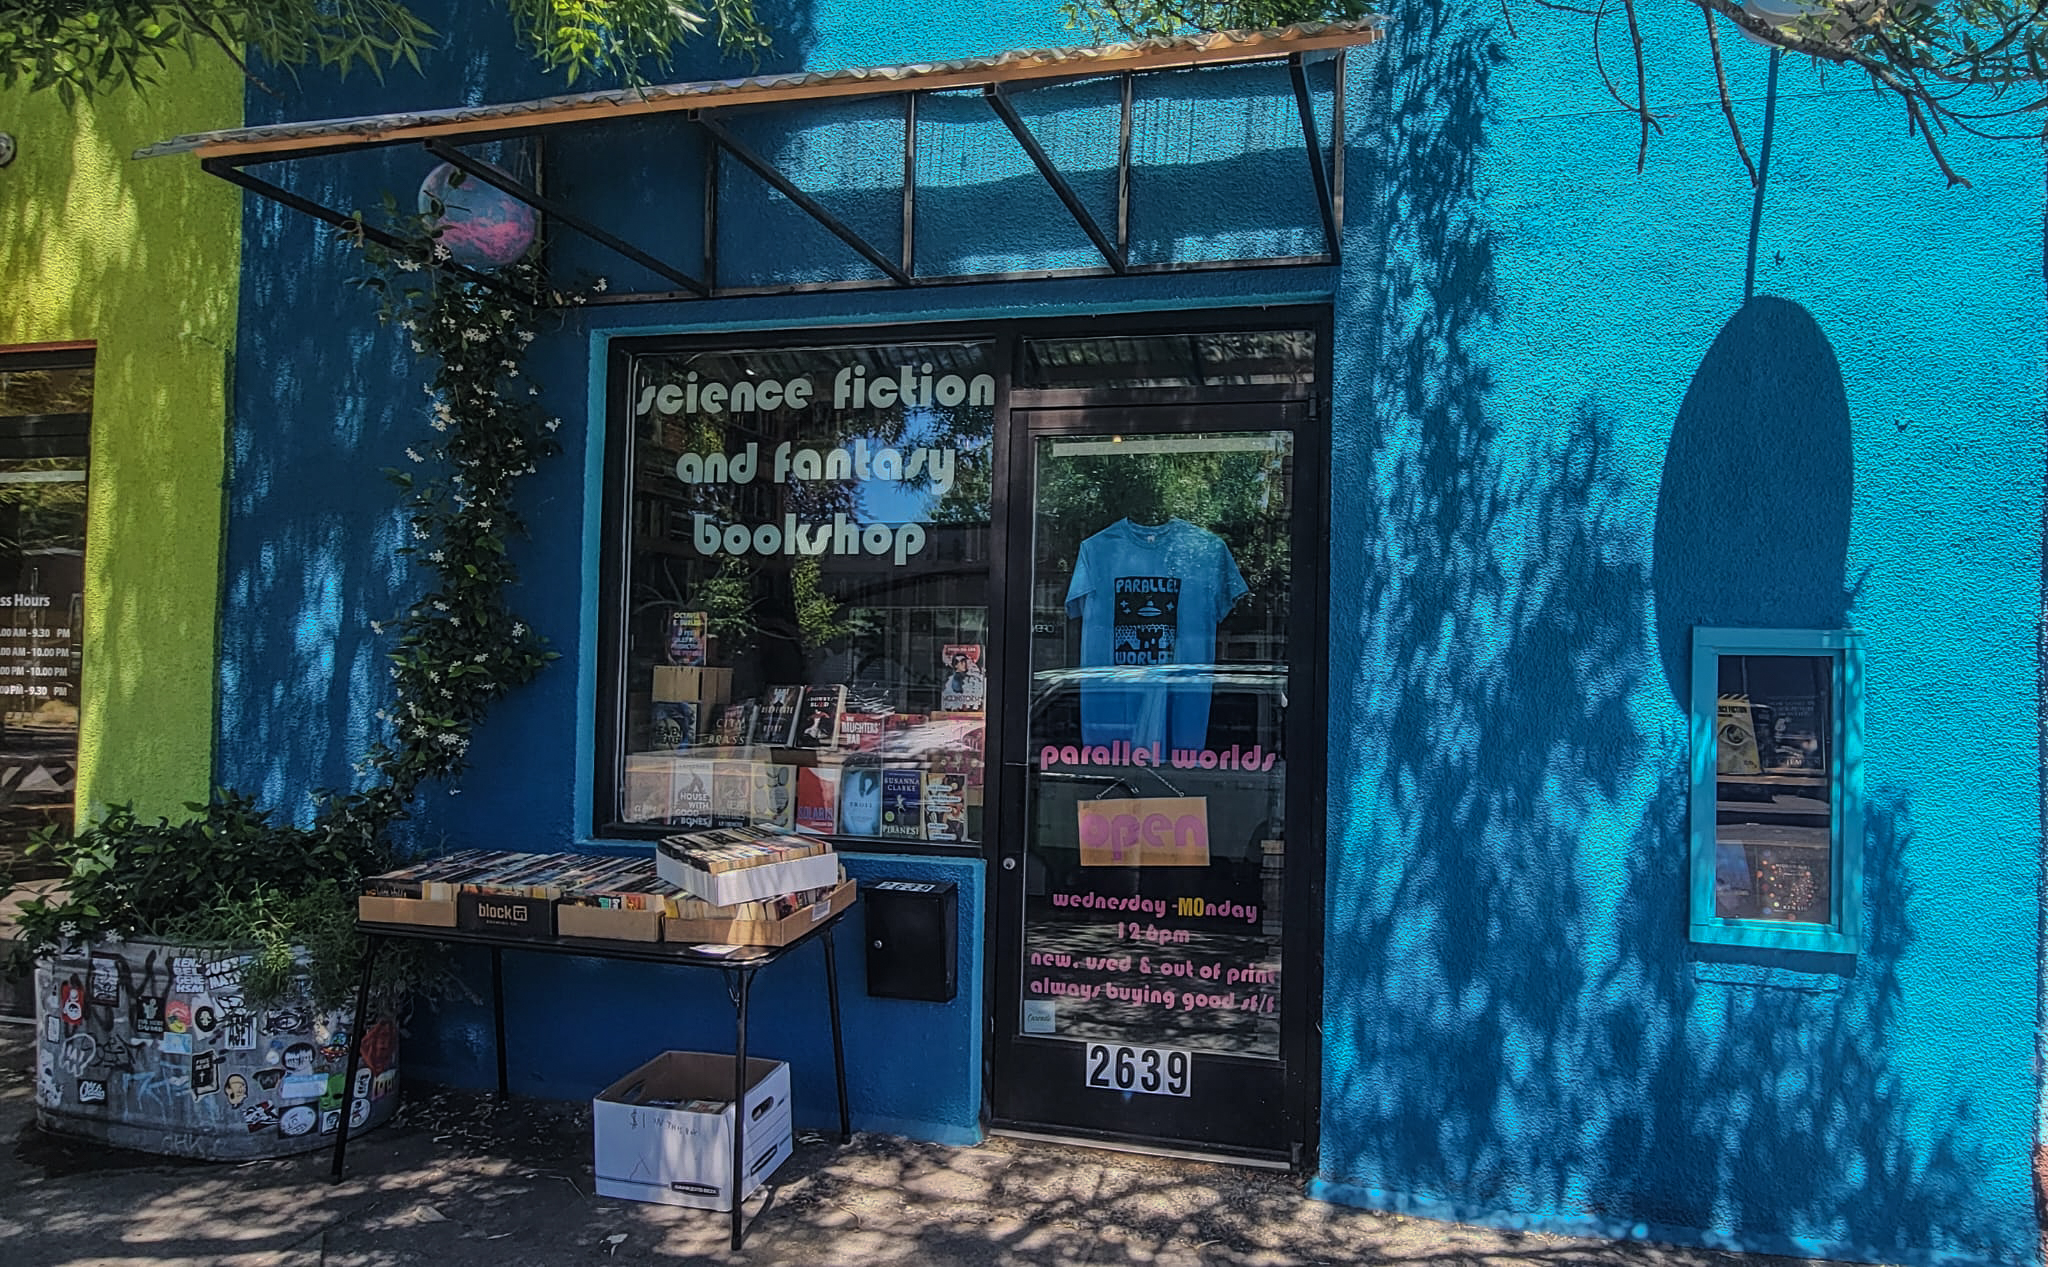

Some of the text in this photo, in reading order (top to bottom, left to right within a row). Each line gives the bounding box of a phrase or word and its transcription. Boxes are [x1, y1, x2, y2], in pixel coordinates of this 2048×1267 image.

[636, 362, 995, 416] science fiction
[676, 439, 956, 495] and fantasy
[693, 513, 926, 566] bookshop
[1115, 579, 1179, 593] PARALLEL
[14, 594, 50, 607] Hours
[13, 628, 27, 638] AM
[57, 628, 70, 638] PM
[12, 647, 26, 657] AM
[56, 648, 69, 657] PM
[11, 666, 24, 676] PM
[54, 667, 67, 677] PM
[10, 685, 24, 695] PM
[53, 686, 67, 696] PM
[1040, 740, 1276, 772] parallel worlds
[884, 777, 920, 785] SUSANNA
[680, 792, 708, 800] HOUSE
[675, 808, 700, 816] GOOD
[688, 801, 709, 809] WITH
[1081, 813, 1206, 862] open
[478, 903, 512, 919] block
[1053, 892, 1166, 918] wednesday
[1086, 955, 1132, 972] used
[1139, 956, 1152, 974] &
[1160, 960, 1194, 977] out
[1199, 962, 1221, 980] of
[1226, 963, 1275, 985] print
[1030, 977, 1101, 1001] always
[1106, 982, 1175, 1009] buying
[1182, 992, 1235, 1011] good
[1089, 1045, 1188, 1094] 2639
